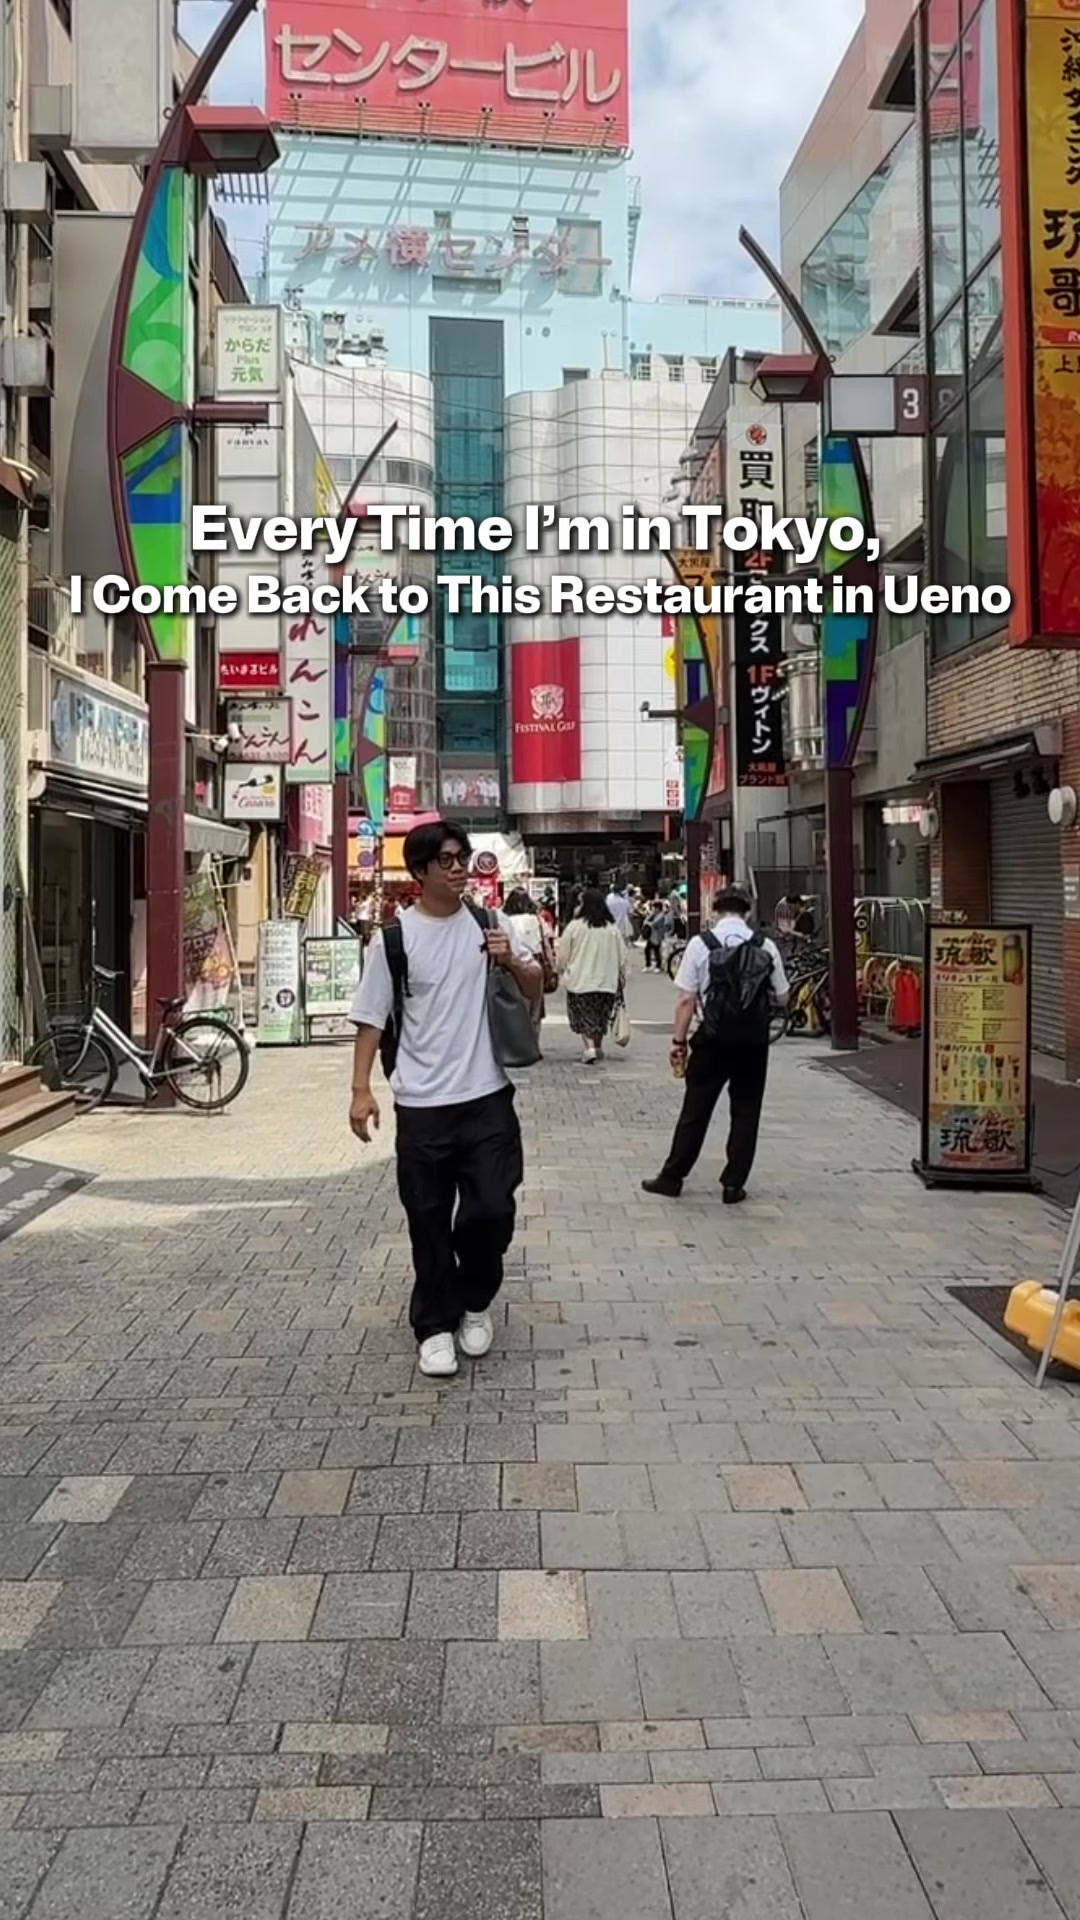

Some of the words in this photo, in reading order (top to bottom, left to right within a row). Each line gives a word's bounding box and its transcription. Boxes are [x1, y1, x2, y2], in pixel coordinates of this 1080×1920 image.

[275, 24, 622, 103] センタービル
[294, 223, 613, 276] アメ横センター
[224, 337, 272, 353] からだ
[231, 366, 263, 382] 元気
[903, 388, 919, 419] 3
[748, 666, 774, 683] 1F
[751, 686, 771, 753] ヴィトン
